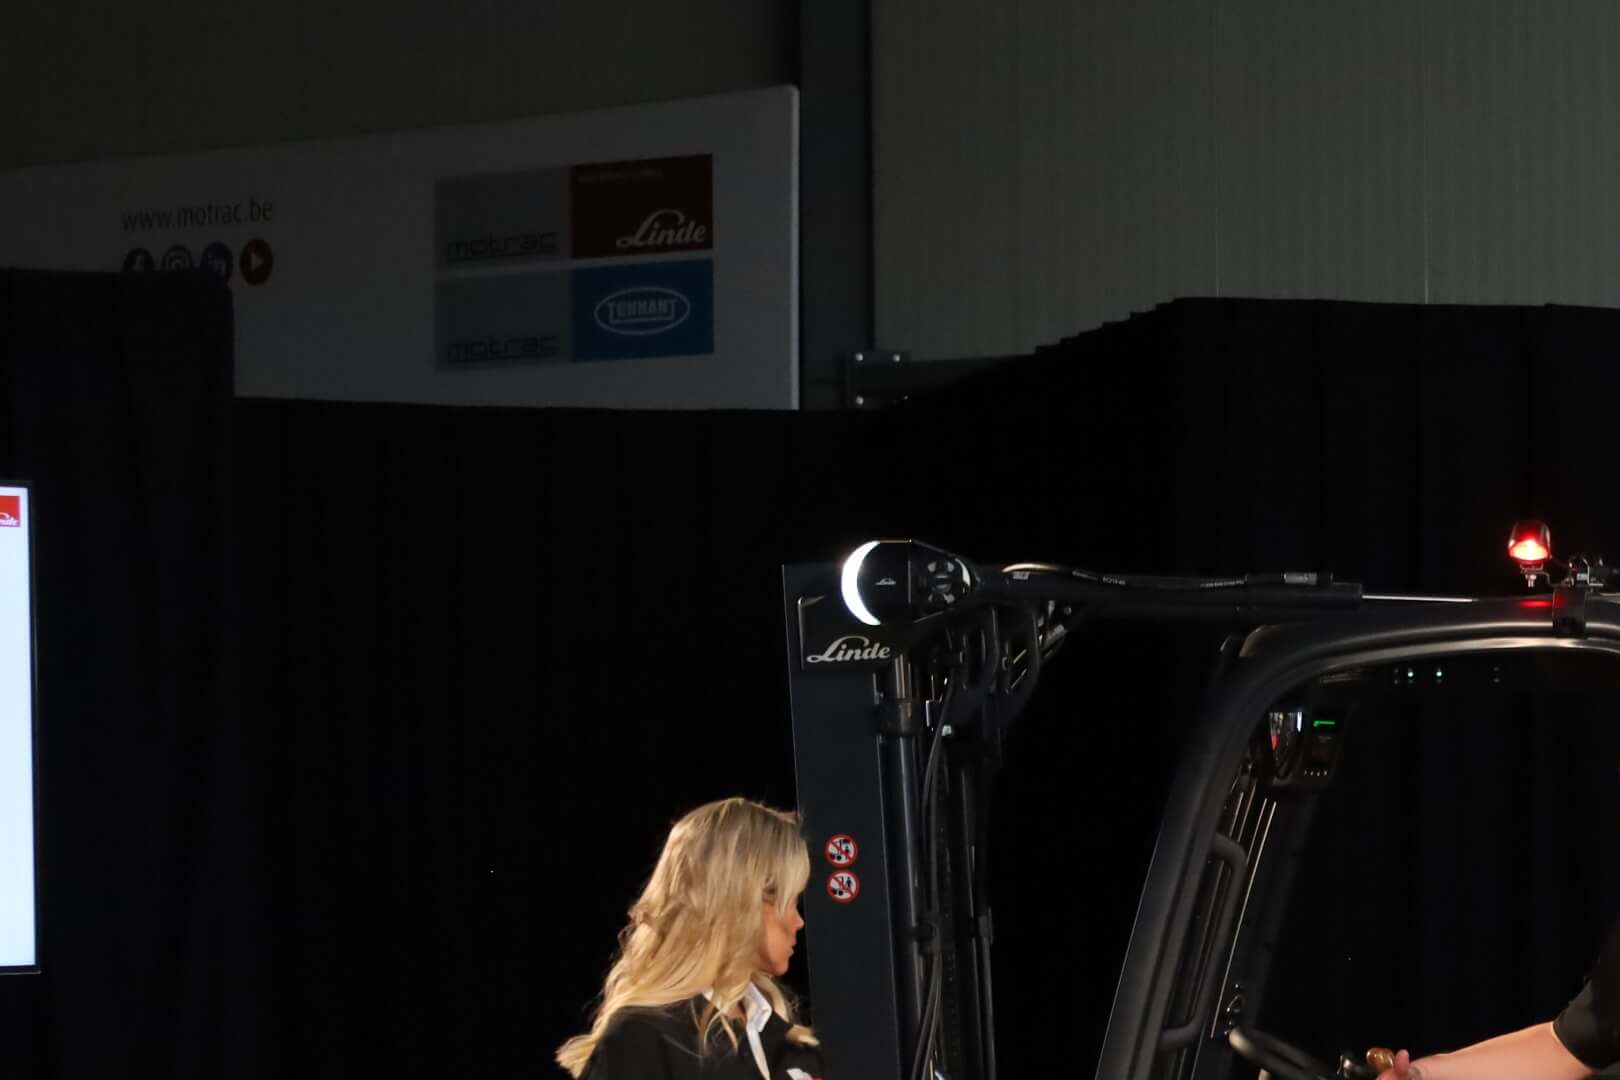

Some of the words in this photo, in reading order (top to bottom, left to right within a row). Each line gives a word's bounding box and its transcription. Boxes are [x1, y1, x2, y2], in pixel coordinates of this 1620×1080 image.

[121, 196, 272, 230] www.motrac.be
[616, 209, 706, 249] Linde
[448, 232, 558, 259] motrac
[448, 335, 558, 362] motrac
[806, 635, 890, 663] Linde
